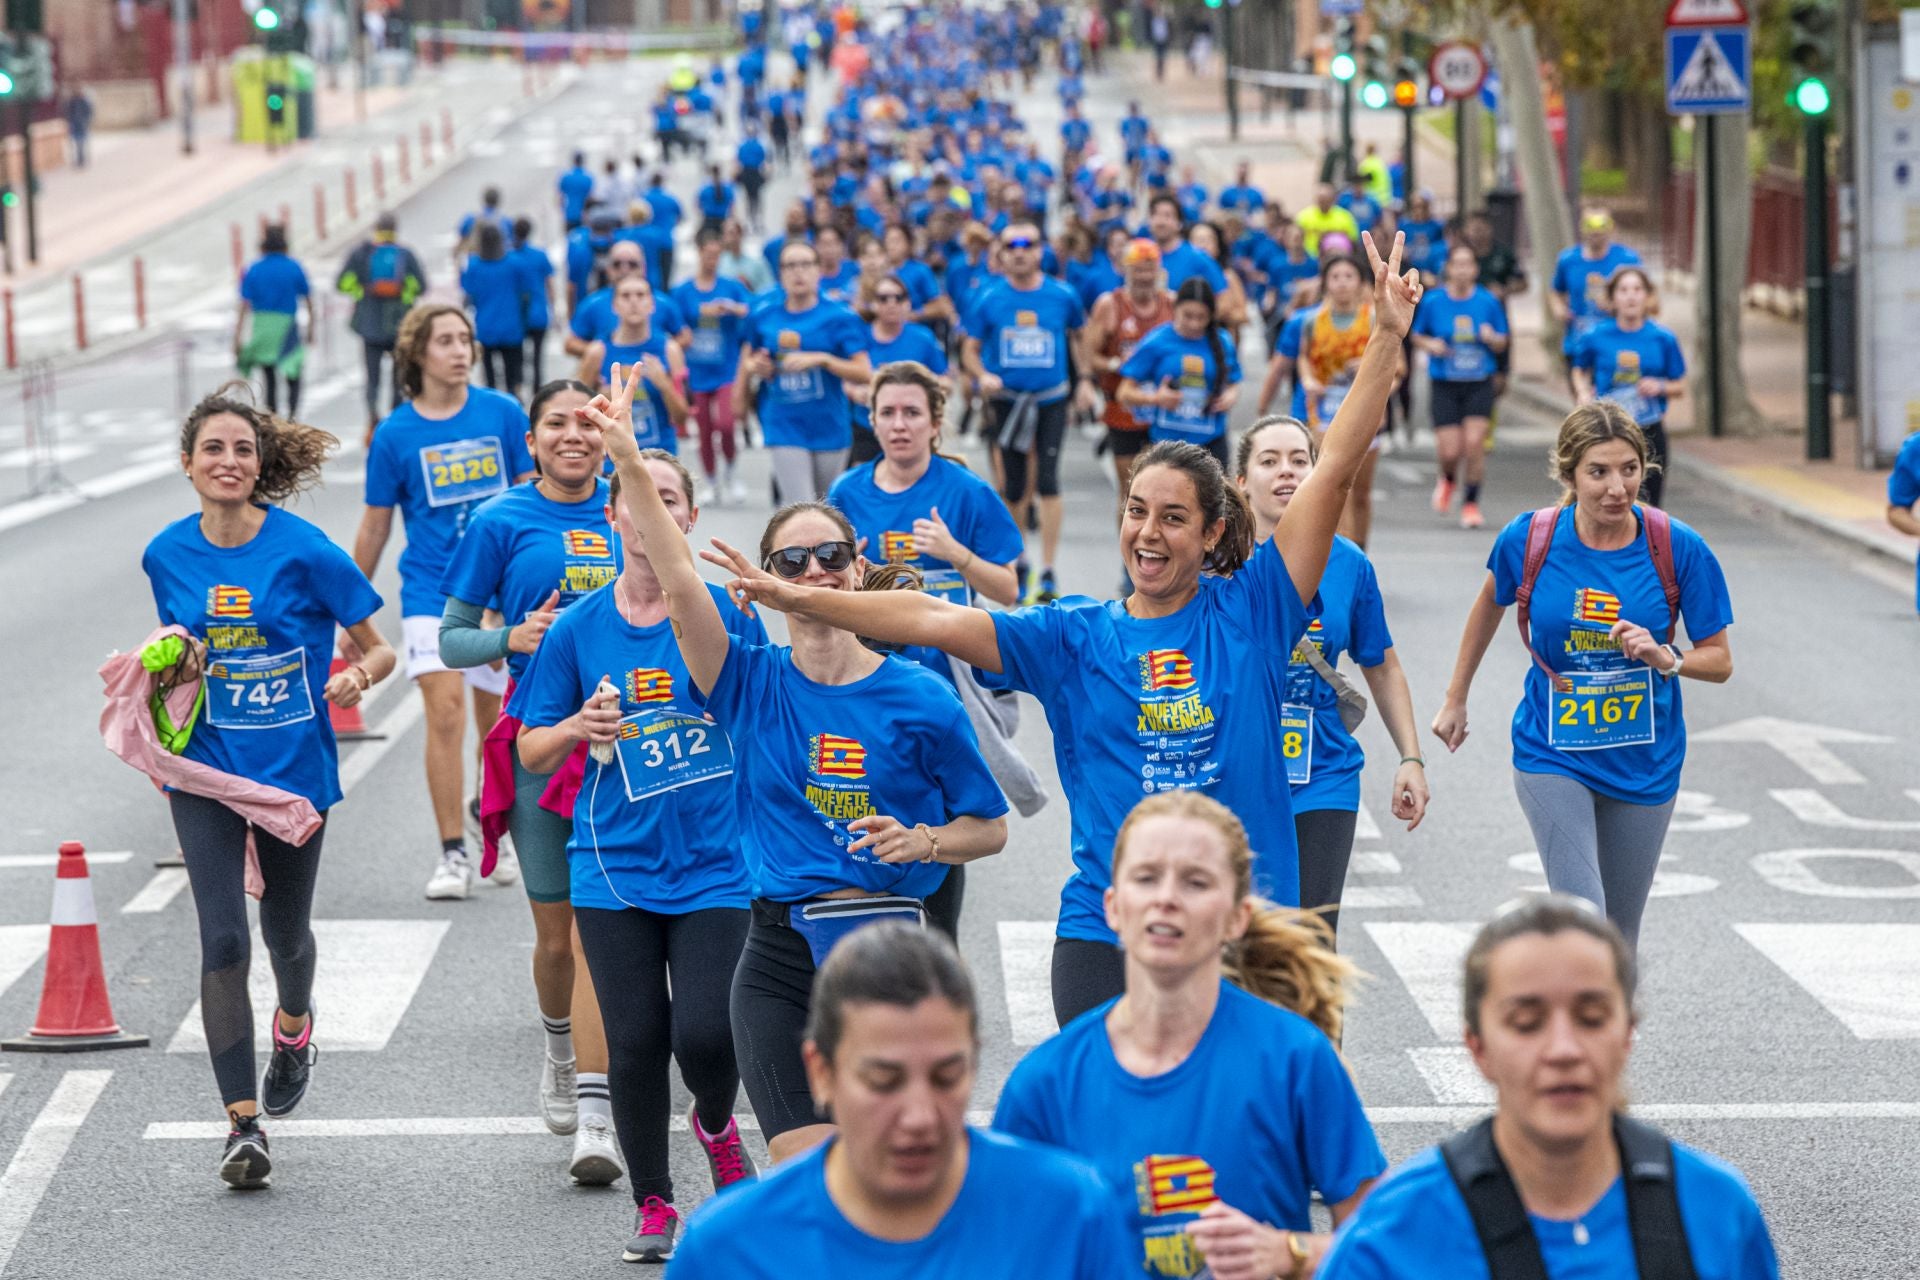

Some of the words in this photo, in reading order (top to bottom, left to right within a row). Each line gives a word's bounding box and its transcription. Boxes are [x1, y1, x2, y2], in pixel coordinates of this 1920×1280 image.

[433, 456, 498, 487] 2826
[1564, 640, 1573, 652] X
[225, 679, 290, 707] 742
[1140, 693, 1203, 718] MUÉVETE
[1136, 715, 1147, 731] X
[1147, 706, 1215, 731] VALENCIA
[1559, 695, 1643, 725] 2167
[1281, 718, 1307, 728] ALENCIA
[640, 728, 710, 768] 312
[1283, 731, 1302, 758] 8
[668, 761, 690, 772] NURIA
[806, 784, 870, 806] MUÉVETE
